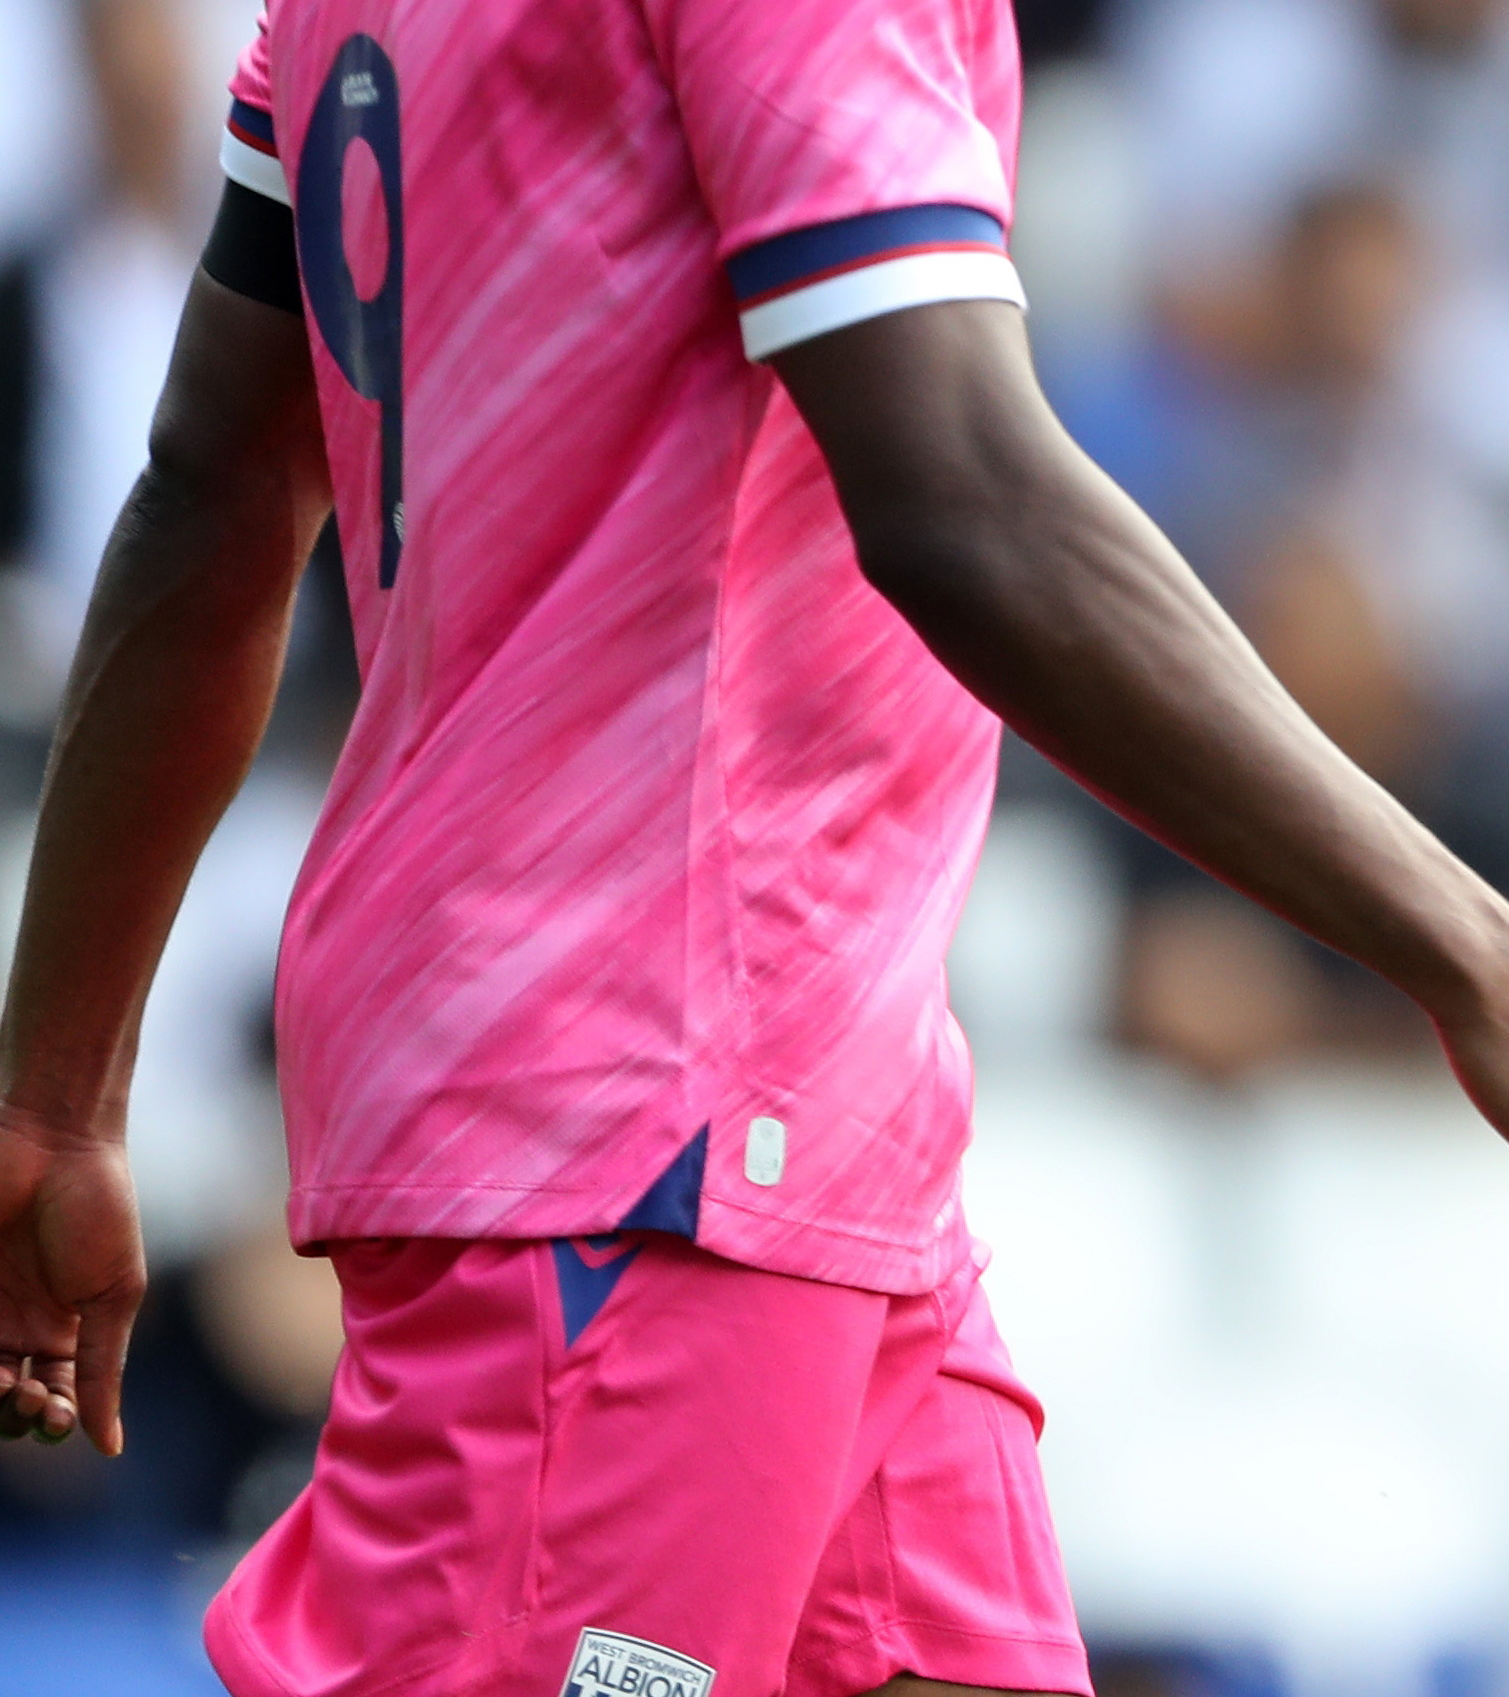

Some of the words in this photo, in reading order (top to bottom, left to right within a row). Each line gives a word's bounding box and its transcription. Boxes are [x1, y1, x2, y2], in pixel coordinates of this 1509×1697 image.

[297, 32, 404, 590] 9
[587, 1638, 625, 1659] WEST
[629, 1653, 701, 1685] BROMWICH
